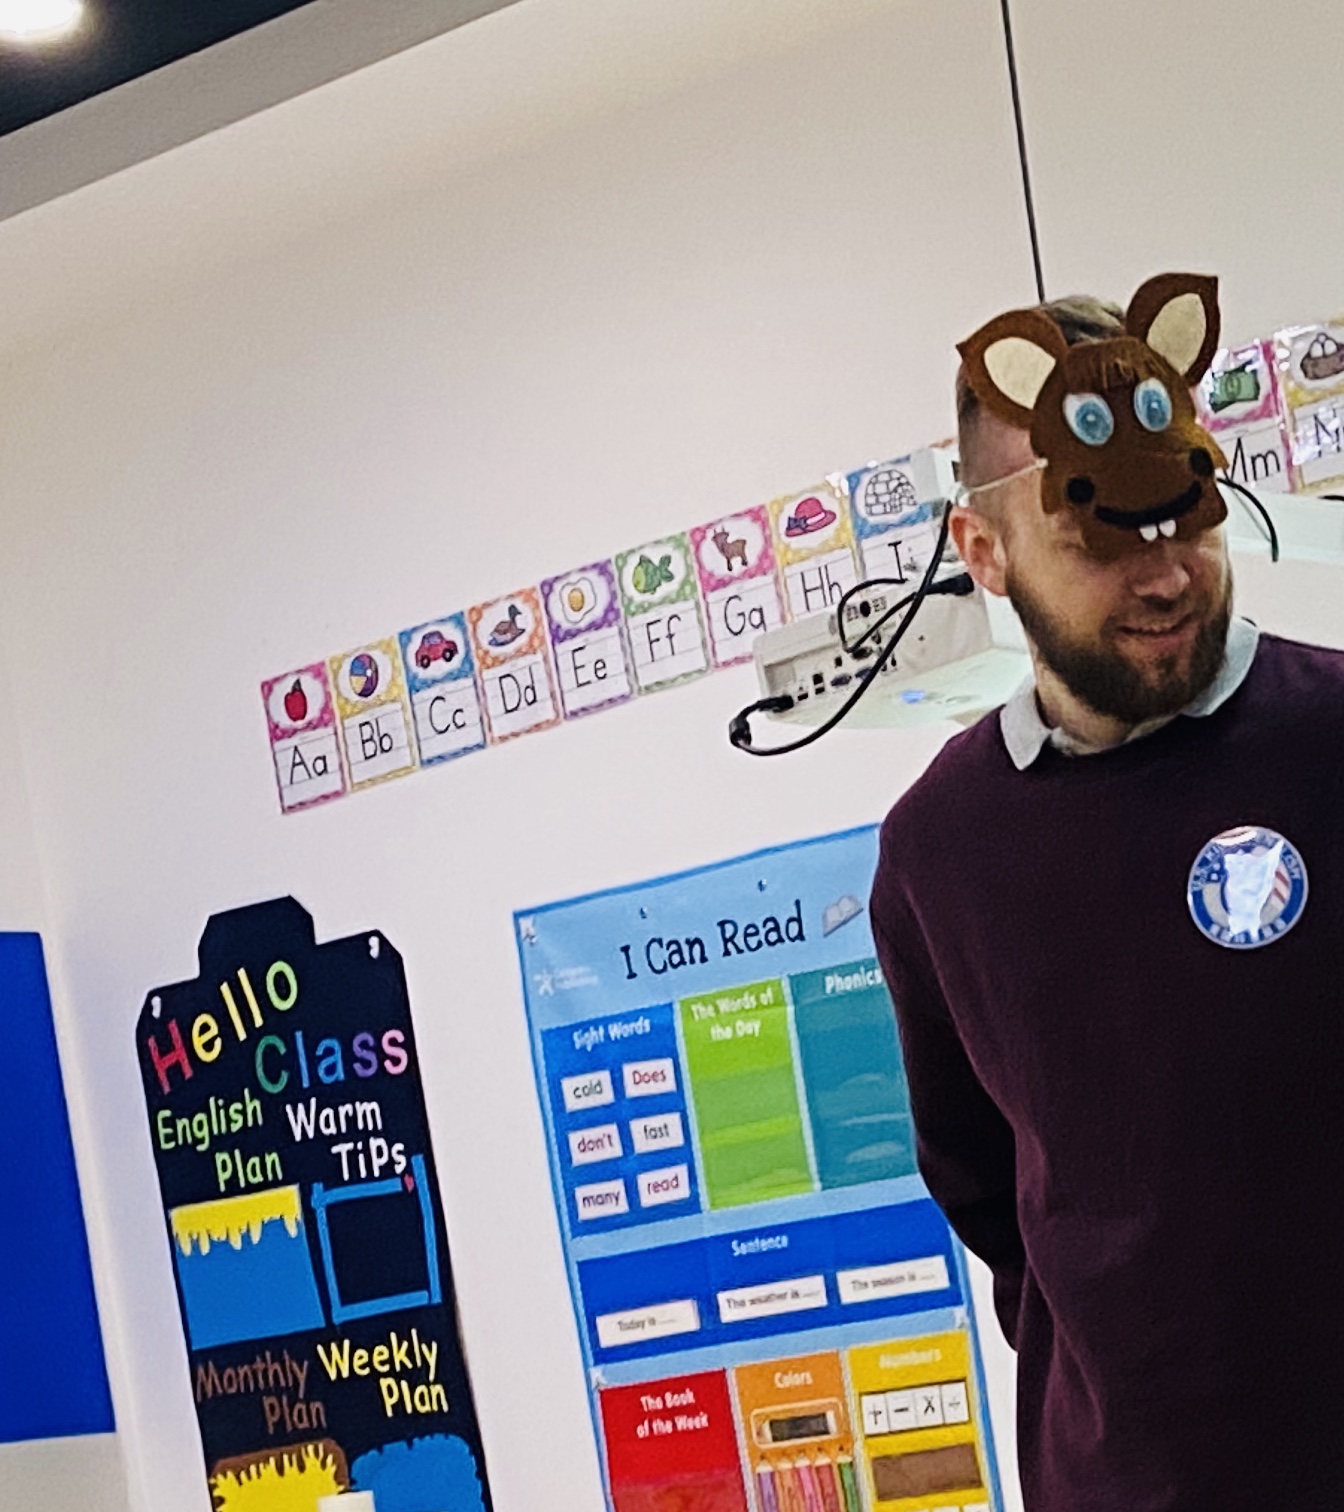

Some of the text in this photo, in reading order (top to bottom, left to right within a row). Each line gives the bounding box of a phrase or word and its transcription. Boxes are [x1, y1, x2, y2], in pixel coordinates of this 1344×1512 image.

[289, 746, 329, 785] Aa
[358, 717, 394, 761] Bb
[428, 696, 467, 735] Cc
[498, 666, 538, 714] Dd
[570, 646, 608, 688] Ee
[645, 614, 682, 663] Ff
[800, 565, 846, 612] Hh
[619, 944, 638, 979] I
[645, 936, 709, 975] Can
[716, 899, 807, 958] Read
[824, 966, 884, 994] Phonics
[690, 987, 775, 1022] The Words of
[147, 960, 299, 1096] Hello
[572, 1016, 651, 1052] Sight Words
[710, 1018, 762, 1041] the Day
[255, 1028, 409, 1094] Class
[573, 1069, 667, 1099] cold Does
[156, 1087, 264, 1151] English
[285, 1096, 383, 1142] Warm
[577, 1123, 670, 1153] don't fast
[214, 1149, 283, 1193] Plan
[582, 1174, 679, 1208] many read
[731, 1235, 789, 1257] Sentence
[726, 1291, 748, 1309] The
[617, 1317, 647, 1333] Today
[316, 1327, 438, 1382] Weekly
[196, 1349, 310, 1402] Monthly
[774, 1371, 813, 1388] Colors
[262, 1395, 328, 1435] Plan
[379, 1377, 449, 1418] Plan
[640, 1388, 696, 1413] The Book
[636, 1412, 709, 1439] of the Week
